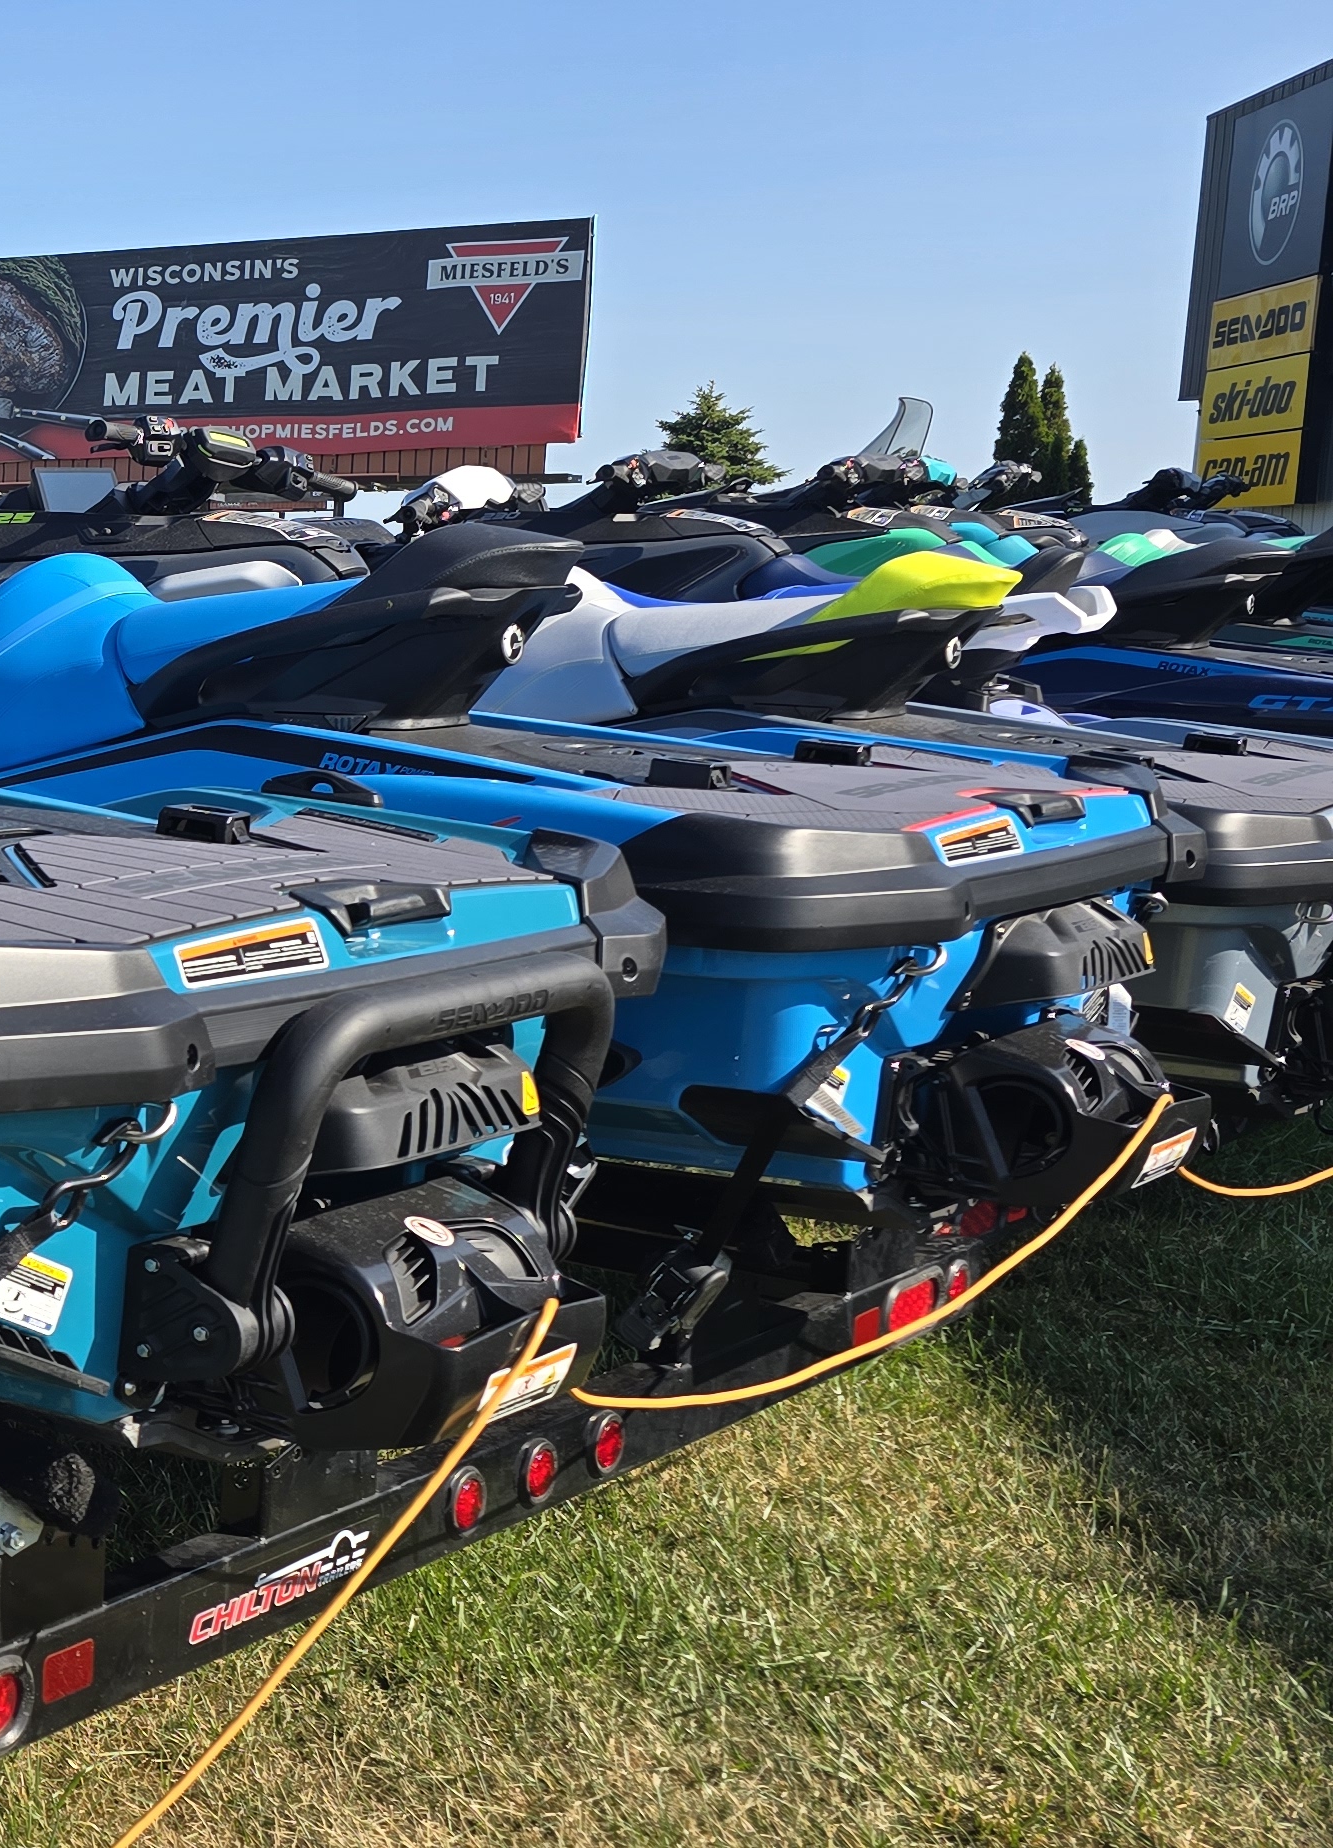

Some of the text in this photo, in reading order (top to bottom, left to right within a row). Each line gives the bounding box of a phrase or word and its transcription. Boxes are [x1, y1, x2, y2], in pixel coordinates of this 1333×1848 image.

[1268, 190, 1298, 219] BRP
[109, 258, 300, 288] WISCONSIN'S
[439, 257, 570, 282] MIESFELD'S
[489, 292, 515, 305] 1941
[112, 283, 403, 375] Premier
[103, 355, 500, 407] MEAT MARKET
[1209, 375, 1297, 425] ski-doo
[226, 416, 454, 440] HOPMIESFELDS.COM
[1157, 660, 1212, 677] ROTAX
[1247, 694, 1333, 712] GT
[188, 1560, 322, 1646] CHILTON
